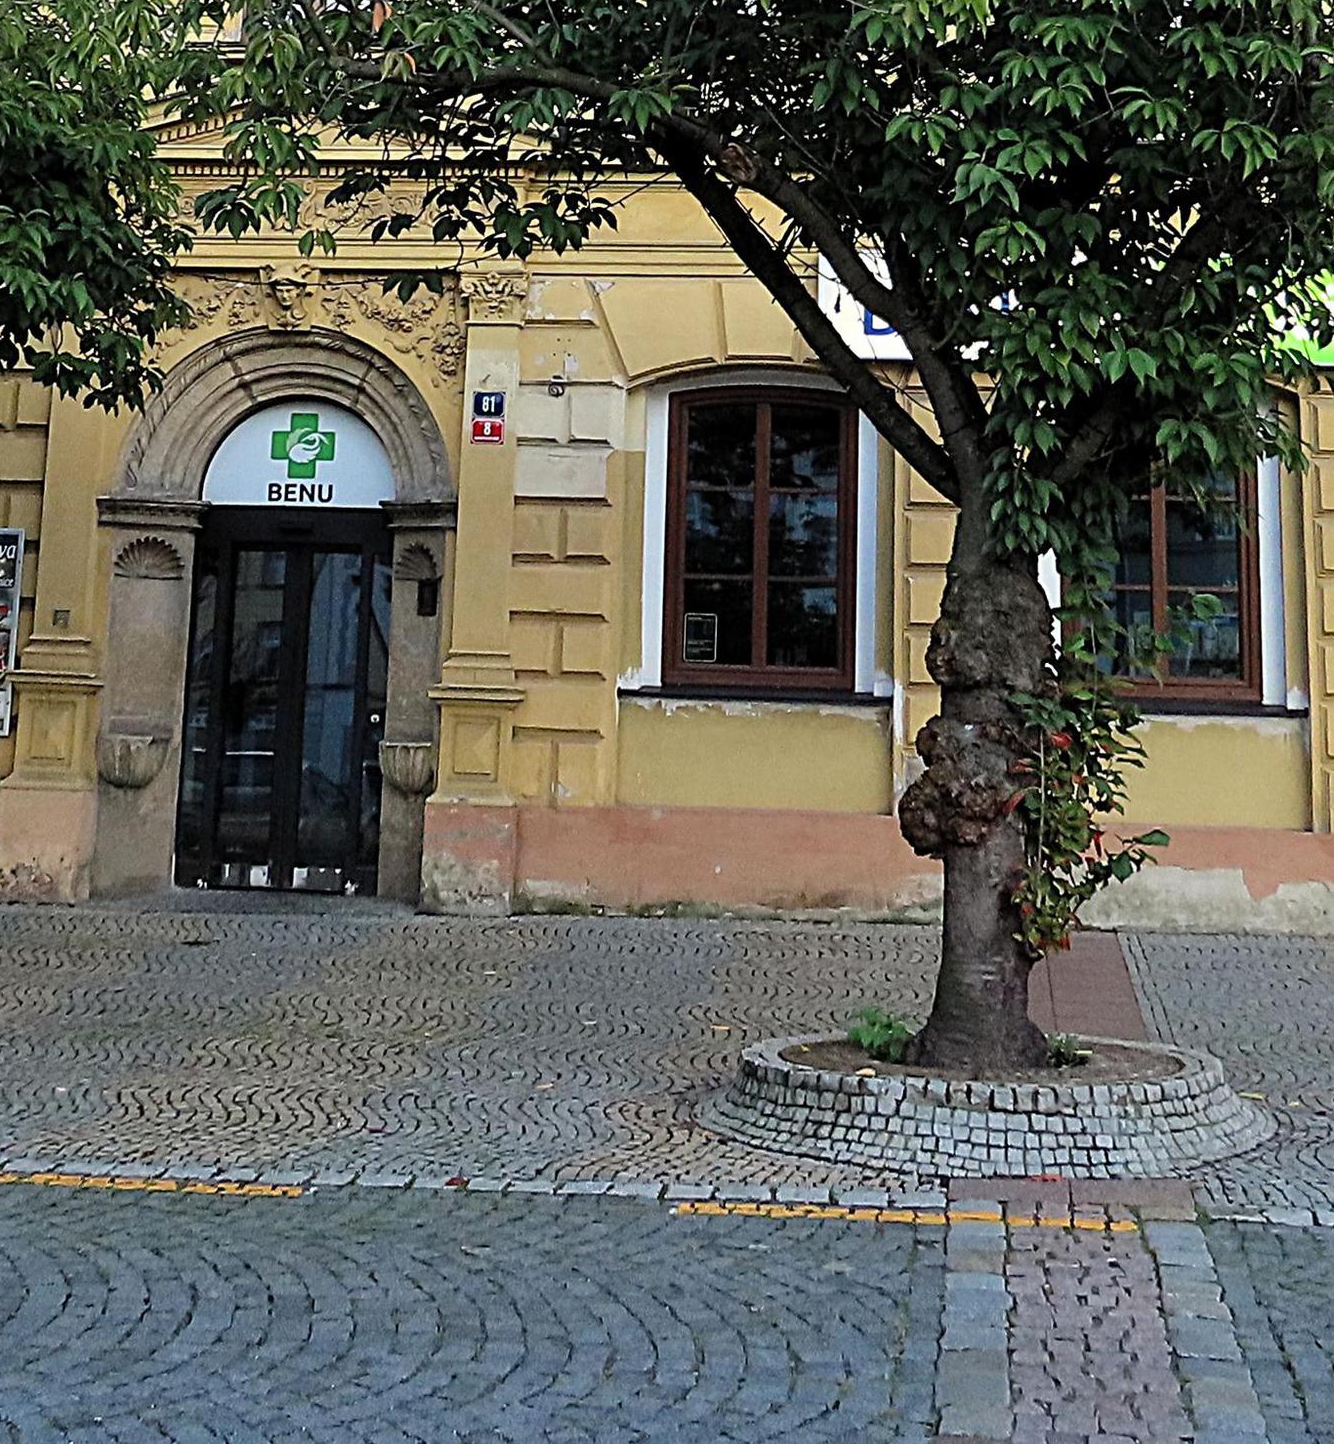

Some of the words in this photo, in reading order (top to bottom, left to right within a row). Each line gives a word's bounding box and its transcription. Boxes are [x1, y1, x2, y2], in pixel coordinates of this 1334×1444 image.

[482, 395, 496, 413] 81
[483, 422, 492, 436] 8
[268, 483, 333, 503] BENU
